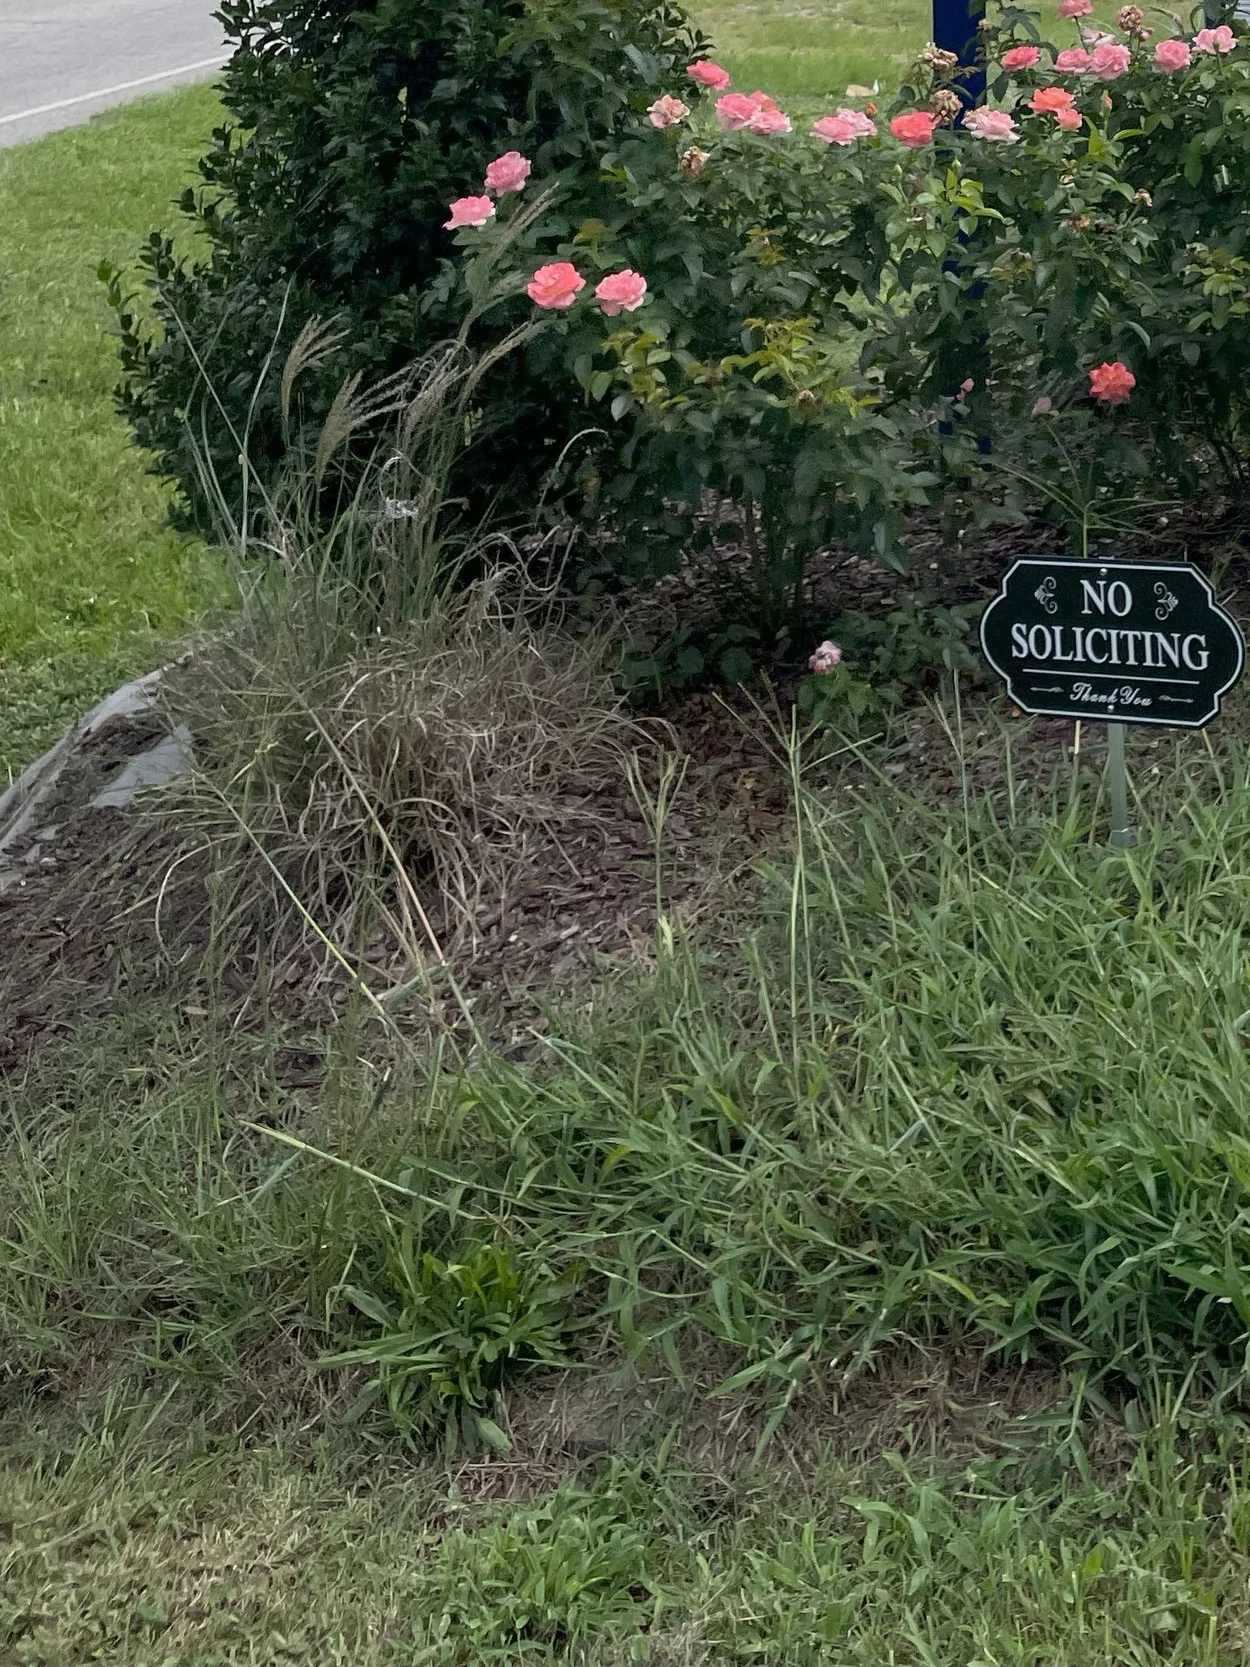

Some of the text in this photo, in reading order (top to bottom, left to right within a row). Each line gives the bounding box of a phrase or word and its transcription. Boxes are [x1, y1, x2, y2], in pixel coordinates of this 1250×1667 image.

[1080, 579, 1132, 616] NO
[1011, 623, 1210, 670] SOLICITING
[1070, 682, 1153, 707] Thank You
